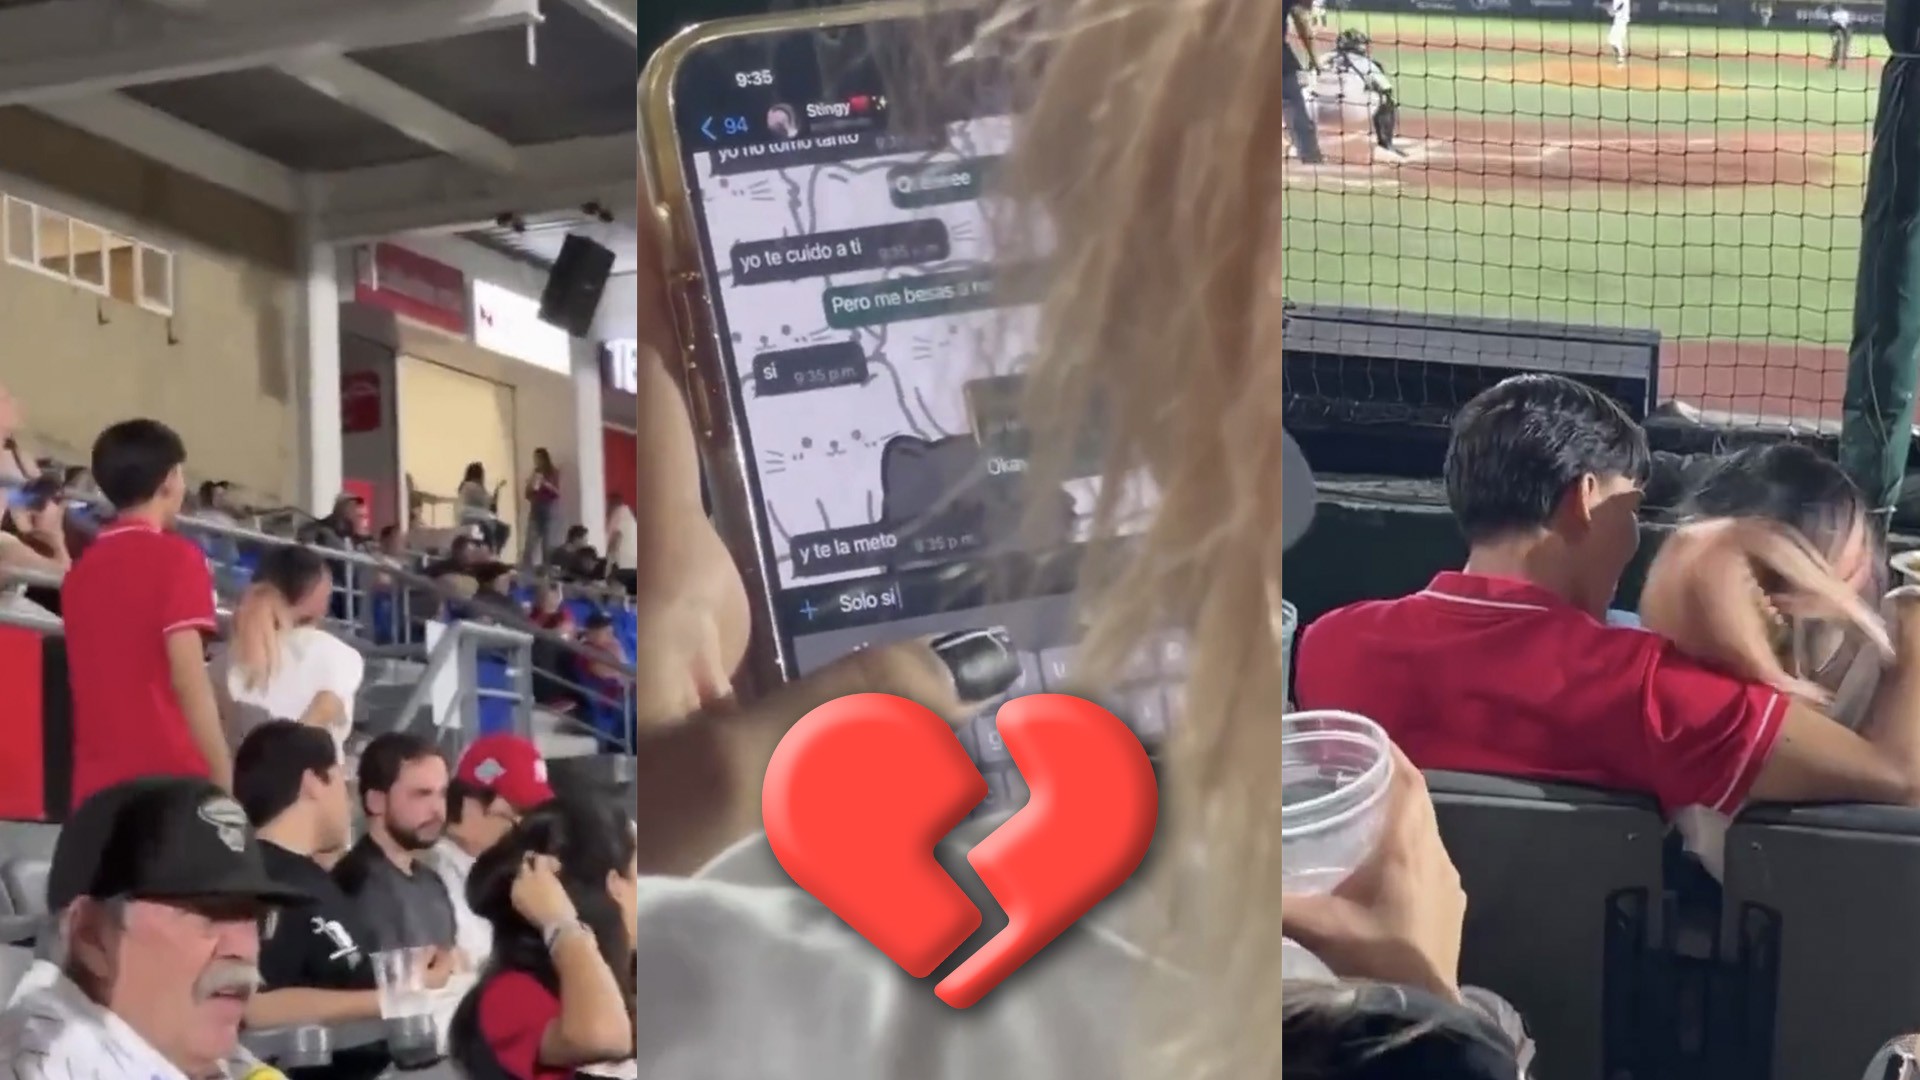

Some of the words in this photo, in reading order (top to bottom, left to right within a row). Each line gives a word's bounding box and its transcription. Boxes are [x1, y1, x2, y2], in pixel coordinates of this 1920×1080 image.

[735, 69, 774, 88] 9:35
[723, 116, 749, 134] 94
[806, 101, 851, 119] Stingy
[740, 254, 761, 274] yo
[764, 249, 783, 267] te
[786, 242, 832, 263] cuido
[836, 243, 848, 257] a
[849, 237, 862, 255] ti
[831, 295, 872, 315] Pero
[874, 288, 901, 309] me
[903, 285, 954, 305] besas
[763, 362, 778, 381] si
[798, 547, 811, 565] y
[813, 542, 832, 559] te
[835, 538, 852, 557] la
[853, 533, 898, 554] meto
[839, 592, 878, 613] Solo
[881, 587, 896, 607] si
